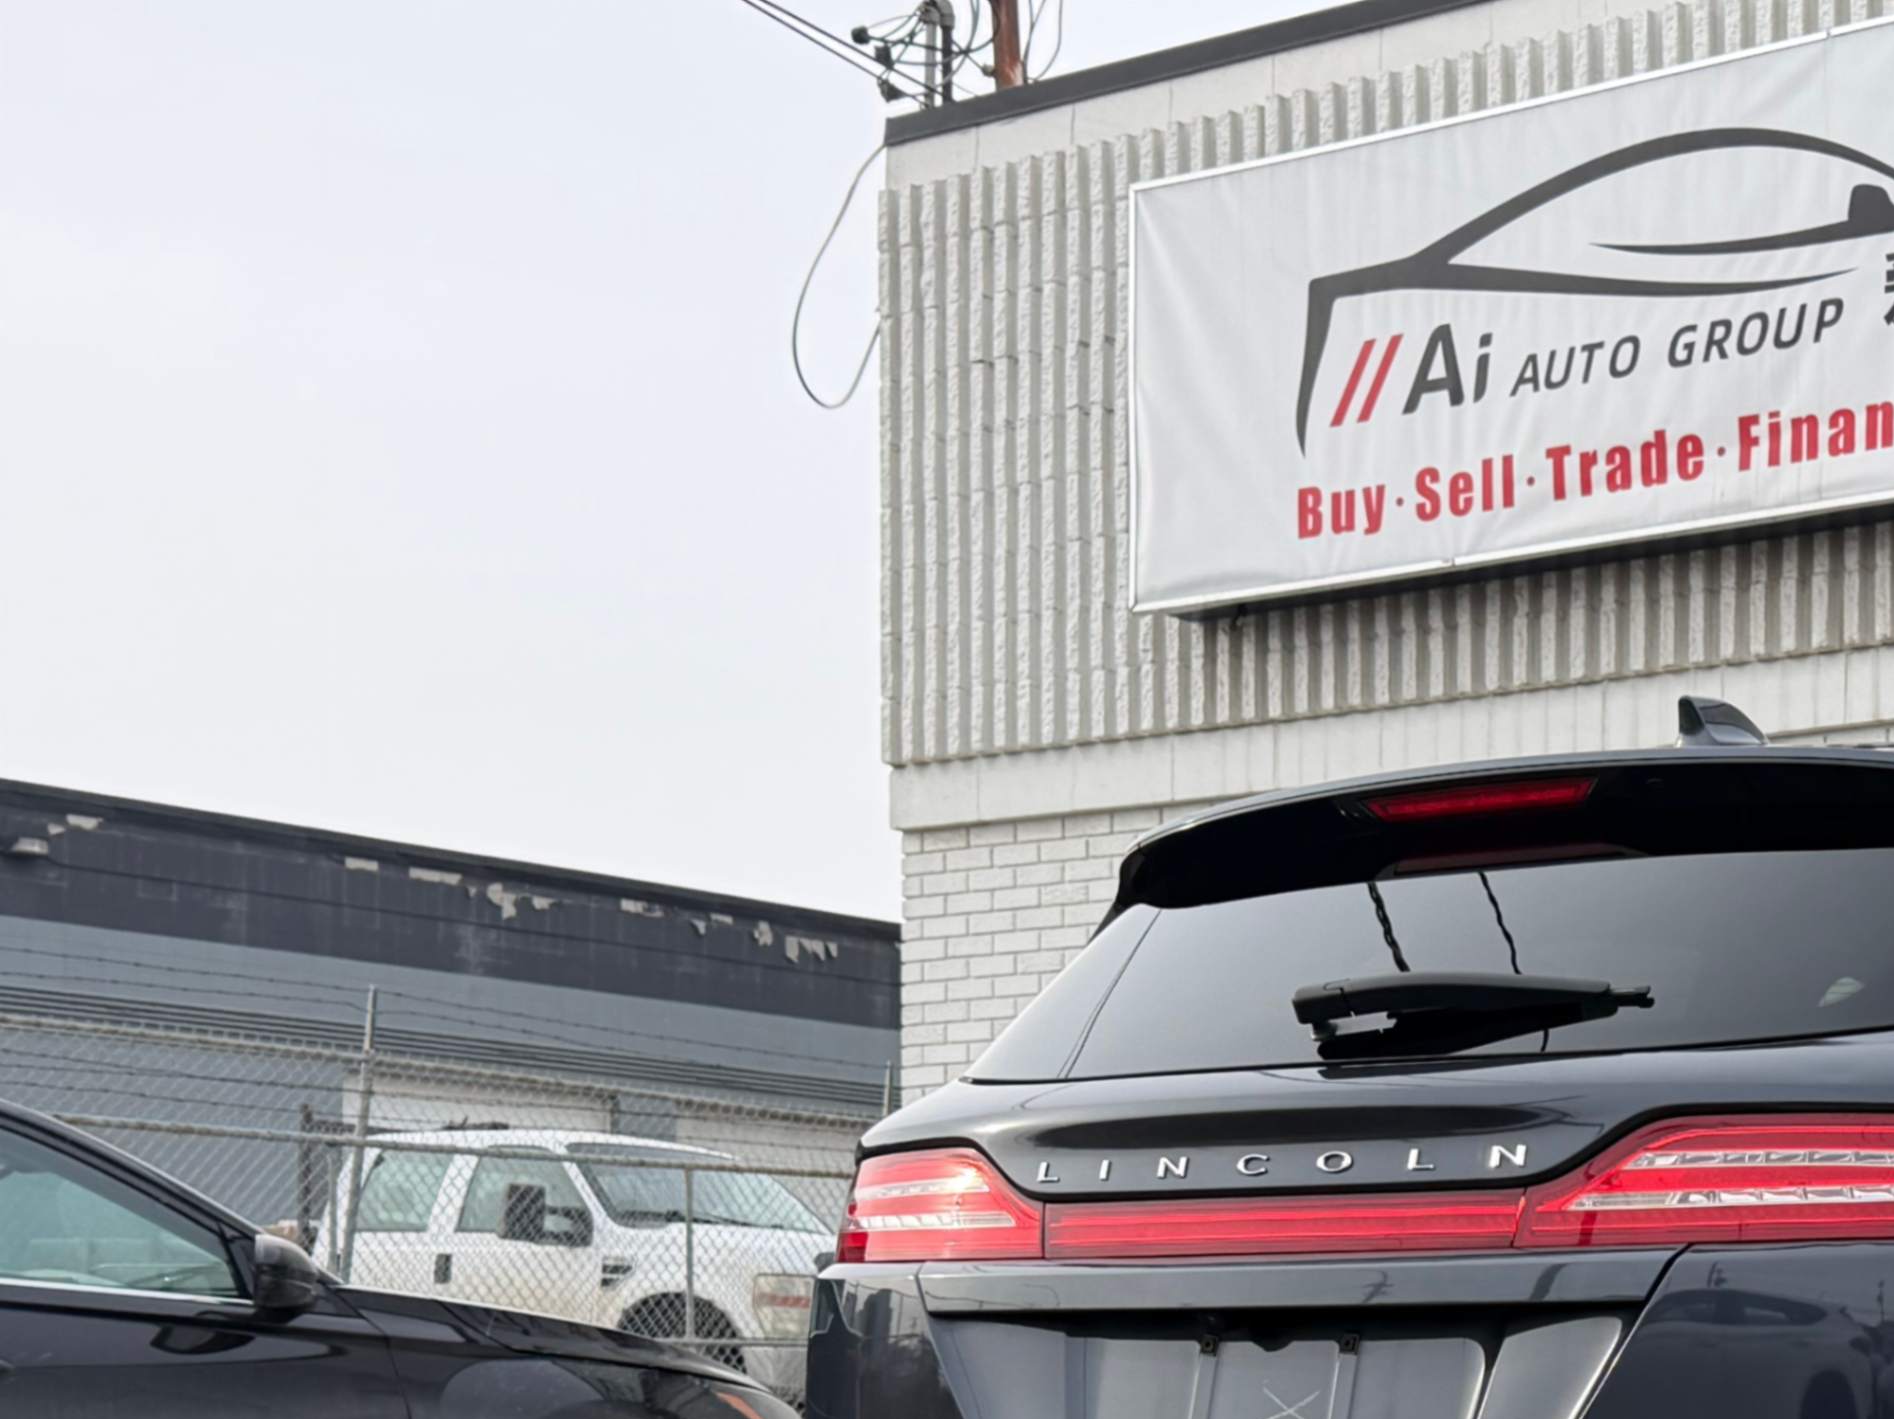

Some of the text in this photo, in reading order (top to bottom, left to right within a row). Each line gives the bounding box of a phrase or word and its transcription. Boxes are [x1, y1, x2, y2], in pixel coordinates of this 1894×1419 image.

[1401, 298, 1845, 415] Ai AUTO GROUP
[1297, 484, 1386, 540] Buy
[1415, 454, 1515, 522] Sell
[1545, 429, 1705, 501] Trade
[1036, 1144, 1529, 1183] LINCOLN
